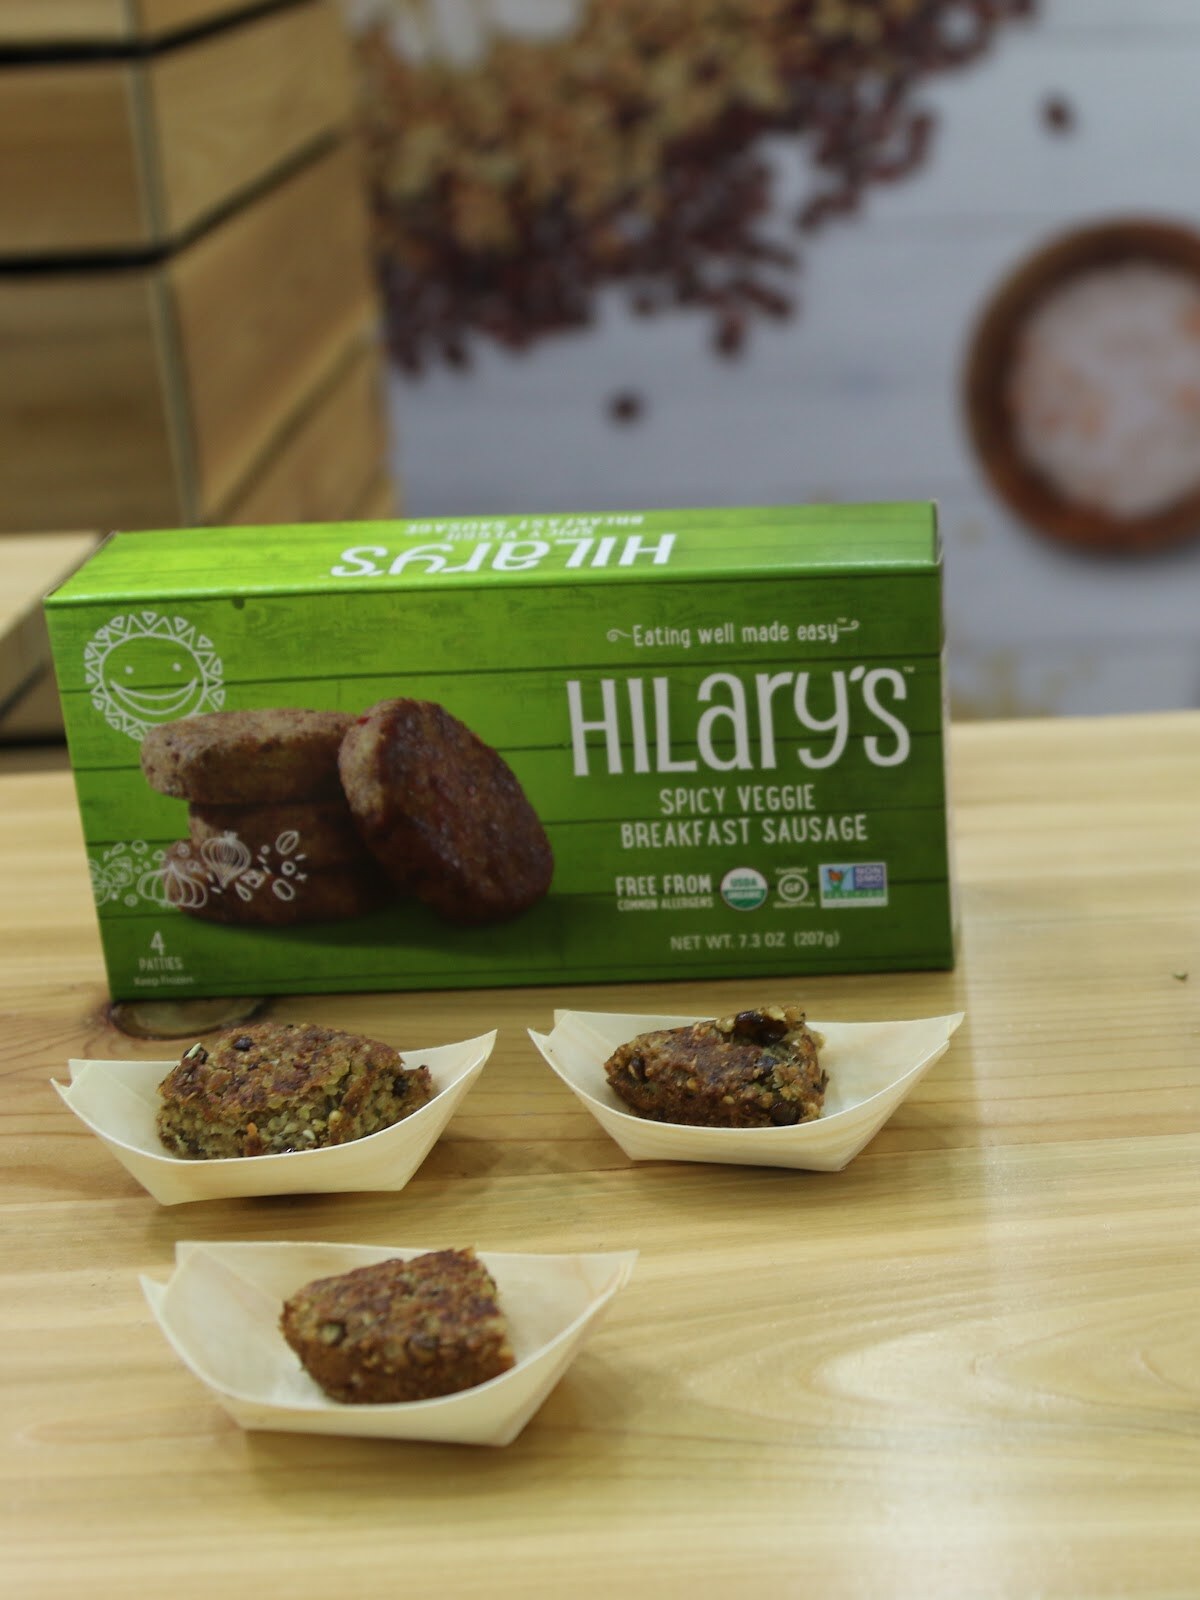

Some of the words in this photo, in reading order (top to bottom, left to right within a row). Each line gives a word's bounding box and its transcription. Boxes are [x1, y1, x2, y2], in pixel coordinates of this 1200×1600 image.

[633, 624, 691, 648] Eating
[698, 622, 735, 644] well
[742, 621, 789, 642] made
[797, 624, 839, 643] easy
[659, 787, 726, 816] SPICY
[739, 784, 815, 812] VEGGIE
[621, 819, 749, 849] BREAKFAST
[762, 815, 868, 843] SAUSAGE
[615, 875, 658, 896] FREE
[663, 874, 712, 895] FROM
[730, 877, 758, 888] USDA
[784, 882, 802, 893] GF
[617, 899, 658, 911] COMMON
[661, 897, 714, 910] ALLERGENS
[150, 930, 165, 955] 4
[670, 936, 703, 951] NET
[705, 935, 733, 950] WT.
[739, 933, 761, 948] 7.3
[765, 932, 786, 946] OZ
[794, 931, 840, 949] (207g)
[139, 957, 184, 971] PATTIES
